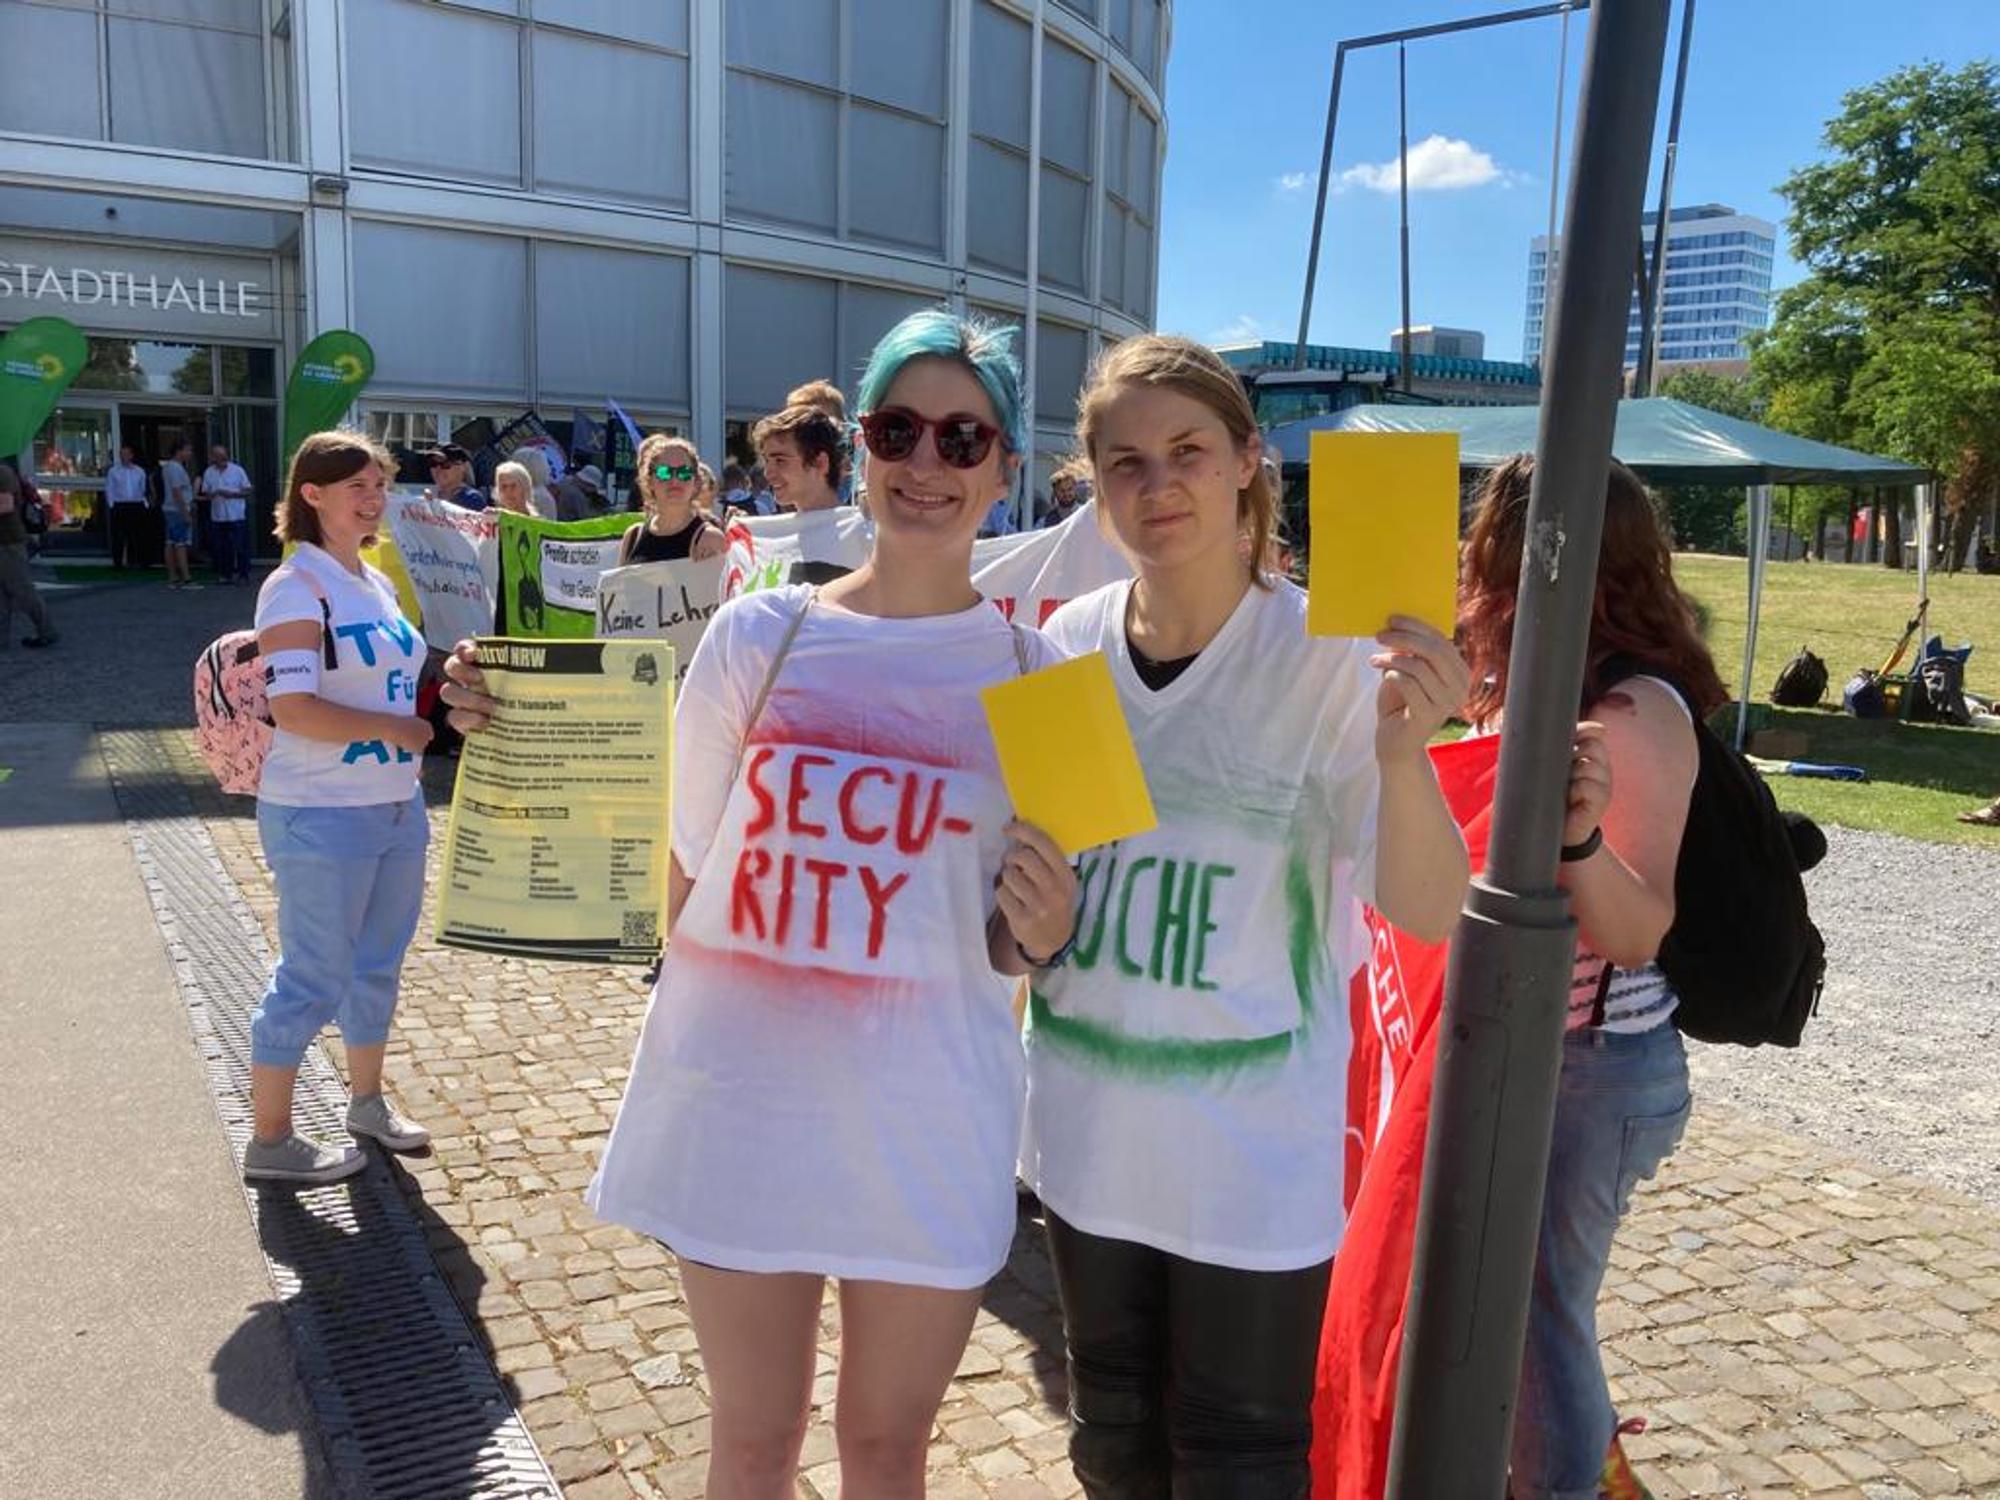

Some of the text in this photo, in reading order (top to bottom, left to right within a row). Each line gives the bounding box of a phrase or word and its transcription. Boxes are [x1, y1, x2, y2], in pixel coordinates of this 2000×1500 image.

[0, 260, 260, 317] STADTHALLE
[335, 616, 416, 668] TV
[600, 592, 646, 635] Keine
[476, 644, 509, 665] otruf
[744, 747, 974, 855] SECU-
[730, 847, 910, 959] RITY
[1071, 841, 1236, 991] ÜCHE
